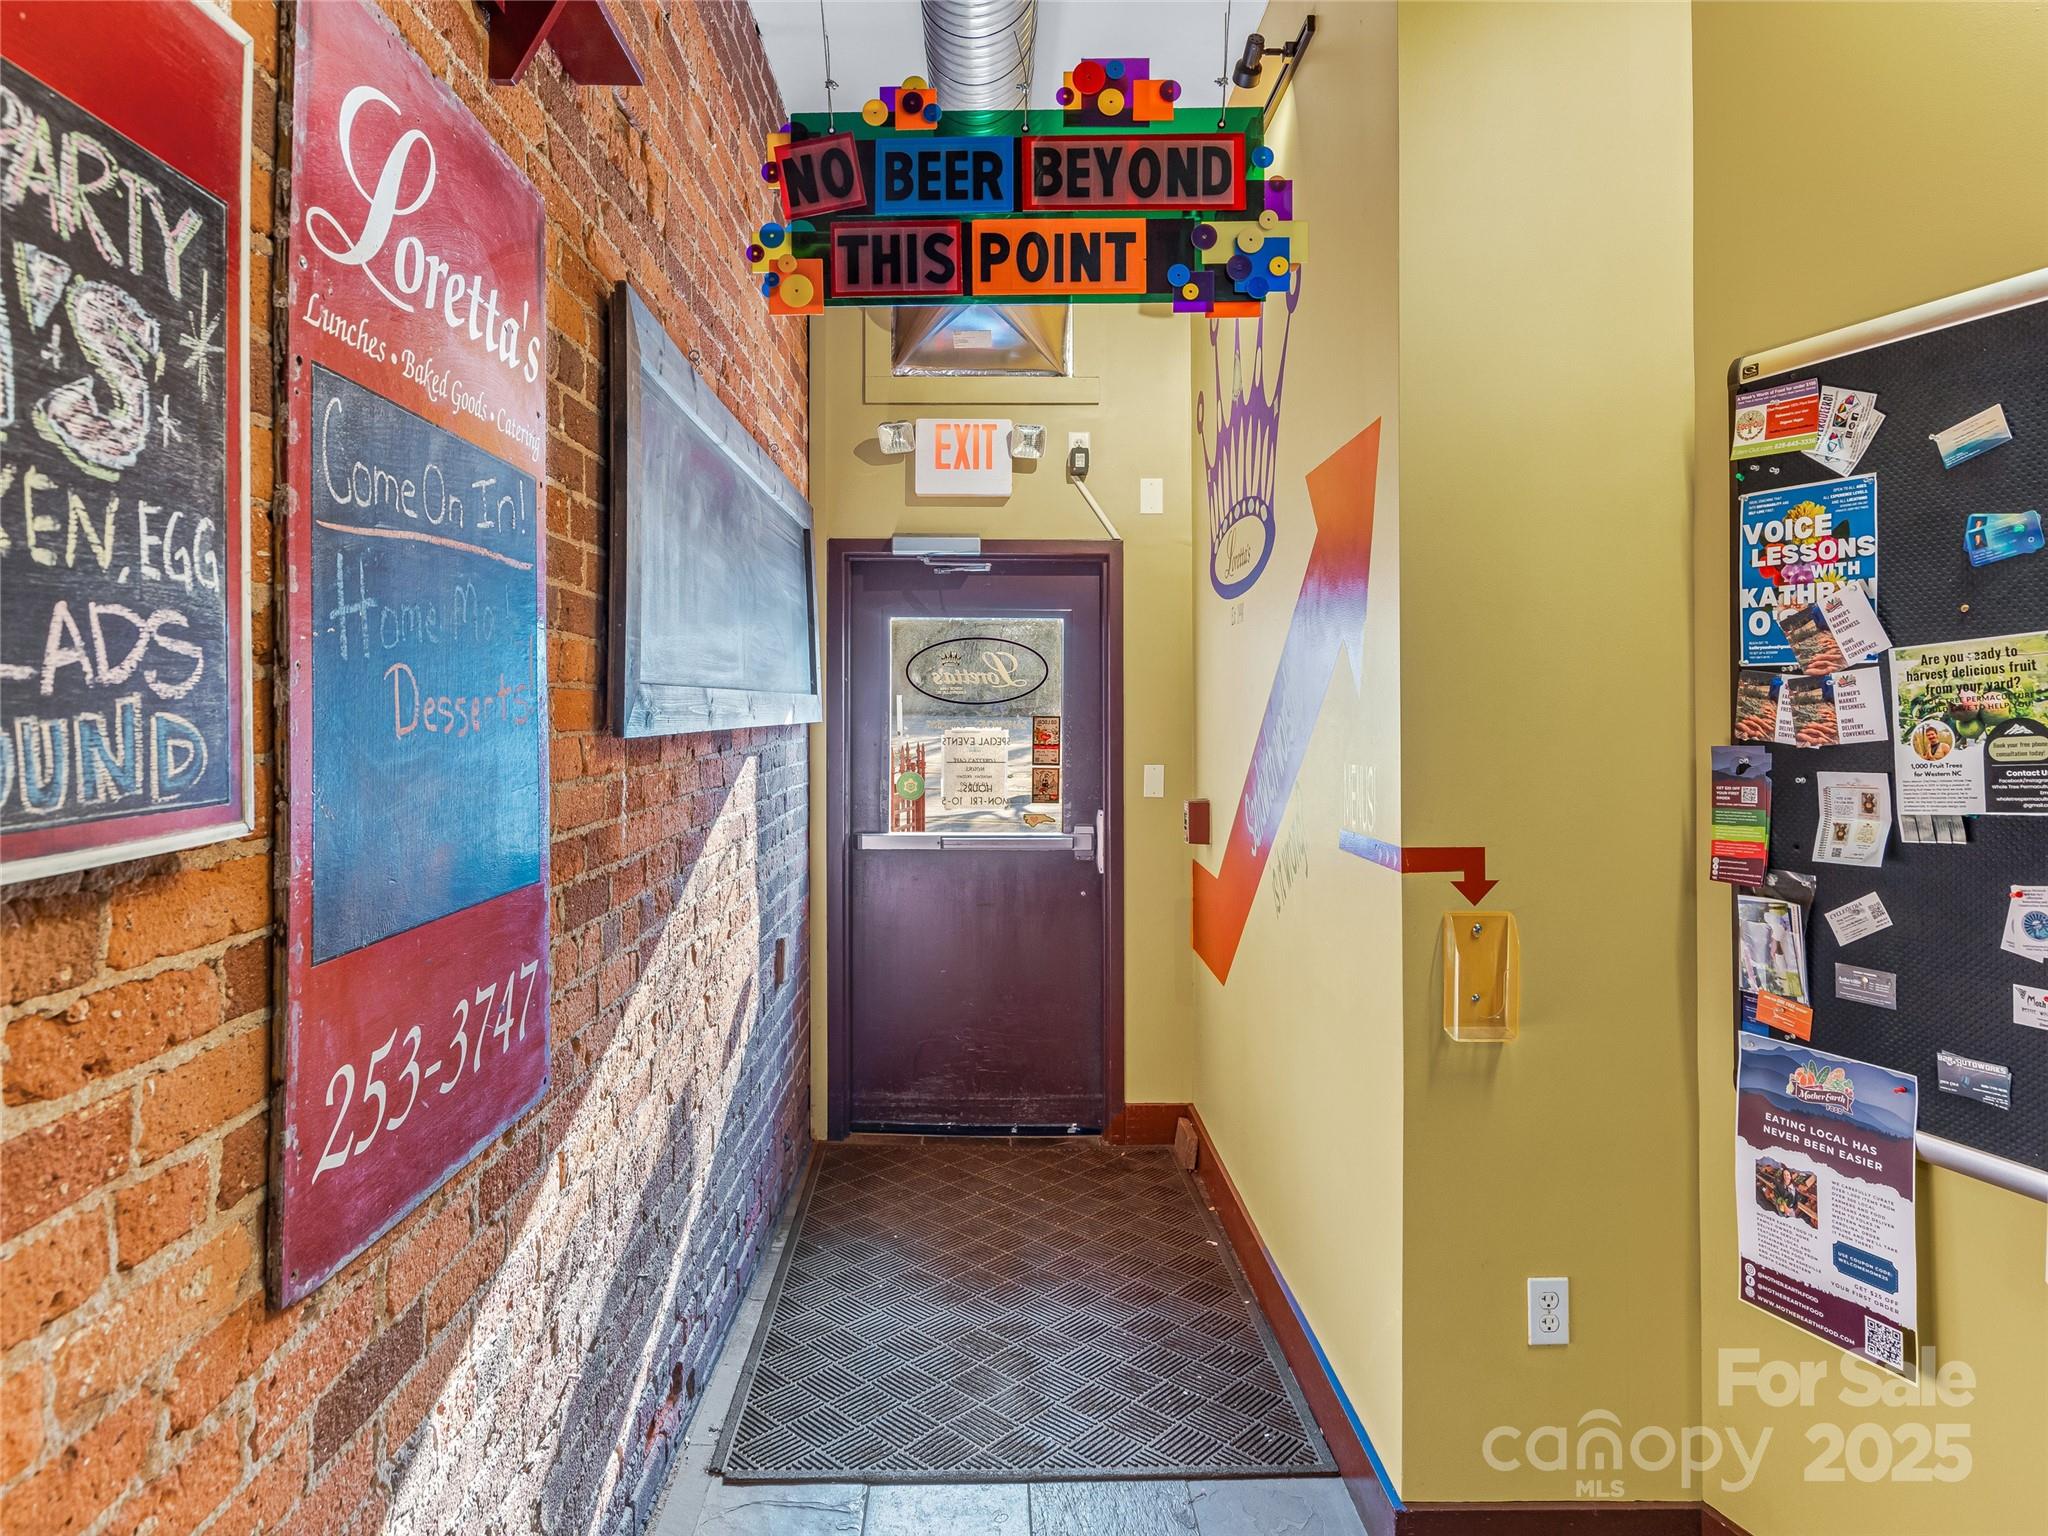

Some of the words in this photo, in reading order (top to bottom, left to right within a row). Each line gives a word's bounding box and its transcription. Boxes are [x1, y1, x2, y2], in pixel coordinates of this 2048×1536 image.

[783, 147, 855, 204] NO
[885, 150, 1004, 201] BEER
[1033, 146, 1233, 198] BEYOND
[306, 85, 541, 384] Loretta's
[838, 233, 955, 287] THIS
[980, 231, 1137, 283] POINT
[302, 292, 386, 362] Lunches
[401, 349, 451, 402] Baked
[452, 380, 488, 422] Goods
[497, 408, 541, 462] Catering
[935, 423, 998, 470] EXIT
[322, 398, 418, 520] Come
[422, 462, 464, 529] On
[471, 478, 527, 535] In!
[1742, 513, 1833, 545] VOICE
[138, 499, 220, 595] EGG
[1751, 535, 1876, 567] LESSONS
[1810, 560, 1860, 578] WITH
[330, 548, 441, 660] Home
[1829, 609, 1851, 622] FARMER'S
[1832, 617, 1851, 629] MARKET
[1842, 637, 1855, 647] HOME
[1845, 640, 1866, 654] DELIVERY
[1920, 654, 1940, 666] Are
[1943, 653, 1964, 666] you
[2005, 646, 2018, 657] to
[1906, 668, 1948, 682] harvest
[1951, 665, 2006, 678] delicious
[2009, 659, 2037, 673] fruit
[1925, 683, 1952, 697] from
[1956, 681, 1983, 695] your
[1986, 676, 2021, 692] yard?
[1966, 692, 2035, 703] PERMACULTURE
[1987, 702, 2010, 710] HELP
[311, 958, 539, 1186] 253-3747
[1799, 1089, 1826, 1101] Mother
[1825, 1093, 1846, 1103] Earth
[1763, 1124, 1800, 1144] NEVER
[1803, 1139, 1835, 1156] BEEN
[1838, 1151, 1883, 1172] EASIER
[1765, 1112, 1806, 1132] EATING
[1810, 1126, 1849, 1147] LOCAL
[1853, 1140, 1878, 1156] HAS
[1841, 1183, 1871, 1197] CAREFULLY
[1837, 1251, 1849, 1260] USE
[1850, 1255, 1874, 1270] COUPON
[1757, 1283, 1824, 1318] @MOTHEREARTHFOOD
[1830, 1281, 1850, 1293] YOUR
[1851, 1290, 1873, 1302] FIRST
[1874, 1300, 1900, 1315] ORDER
[1854, 1284, 1867, 1293] GET
[1870, 1290, 1883, 1300] $25
[1885, 1297, 1899, 1306] OFF
[1757, 1295, 1855, 1346] WWW.MOTHEREARTHFOOD.COM
